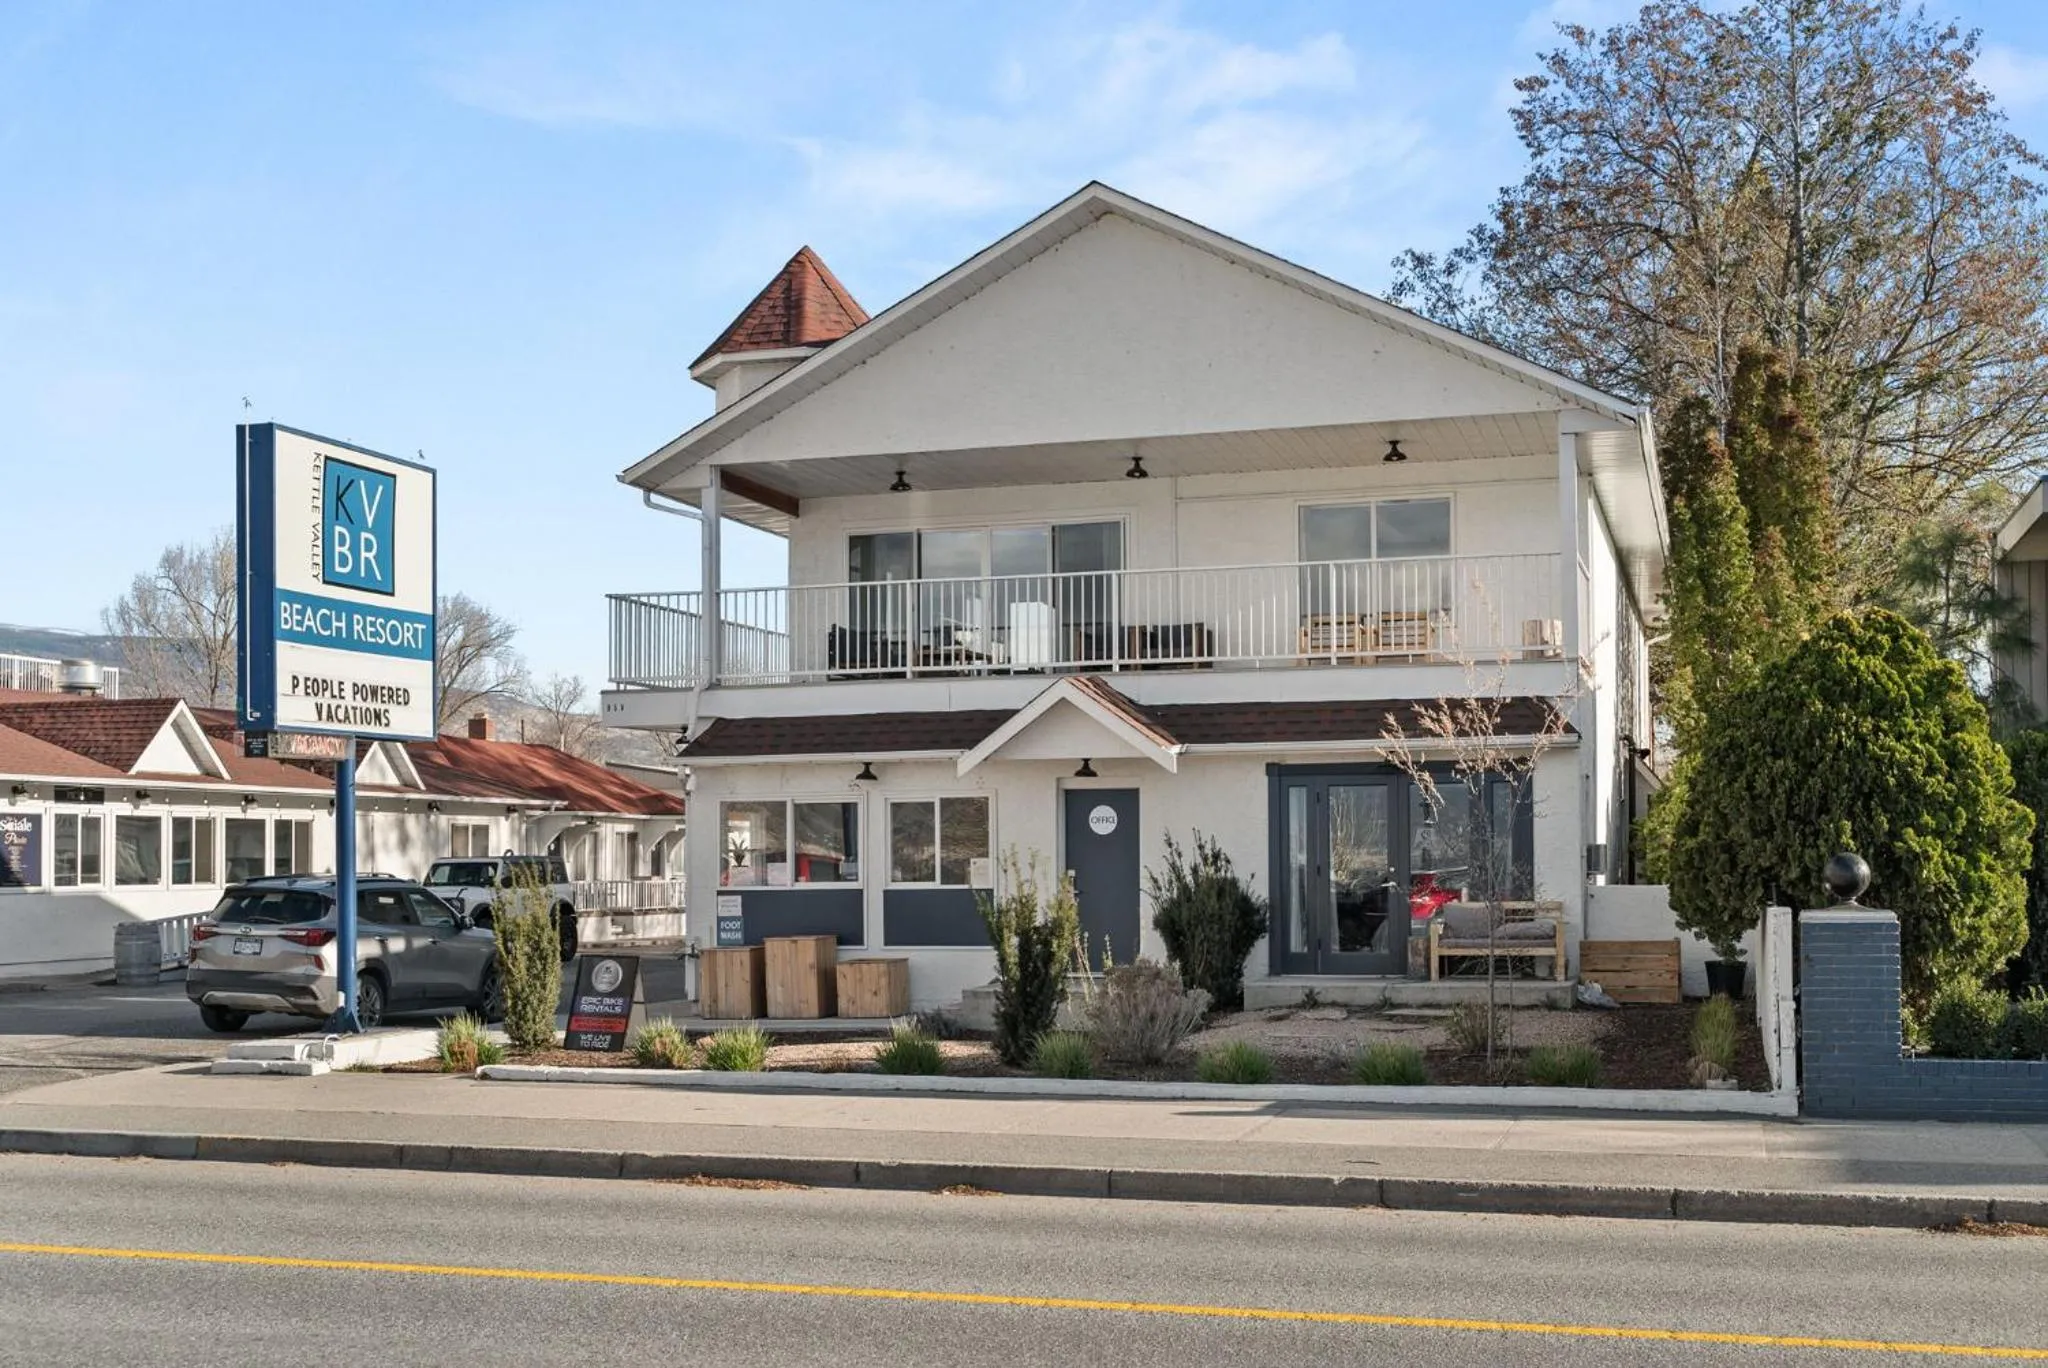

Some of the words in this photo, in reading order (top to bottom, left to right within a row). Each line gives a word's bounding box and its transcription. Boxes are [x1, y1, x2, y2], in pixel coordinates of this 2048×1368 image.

[311, 451, 322, 514] KETTLE
[335, 474, 384, 529] KV
[311, 522, 321, 583] VALLEY
[333, 525, 383, 581] BR
[280, 601, 347, 639] BEACH
[353, 613, 427, 649] RESORT
[291, 674, 346, 700] PEOPLE
[352, 682, 411, 706] POWERED
[314, 702, 391, 728] VACATIONS
